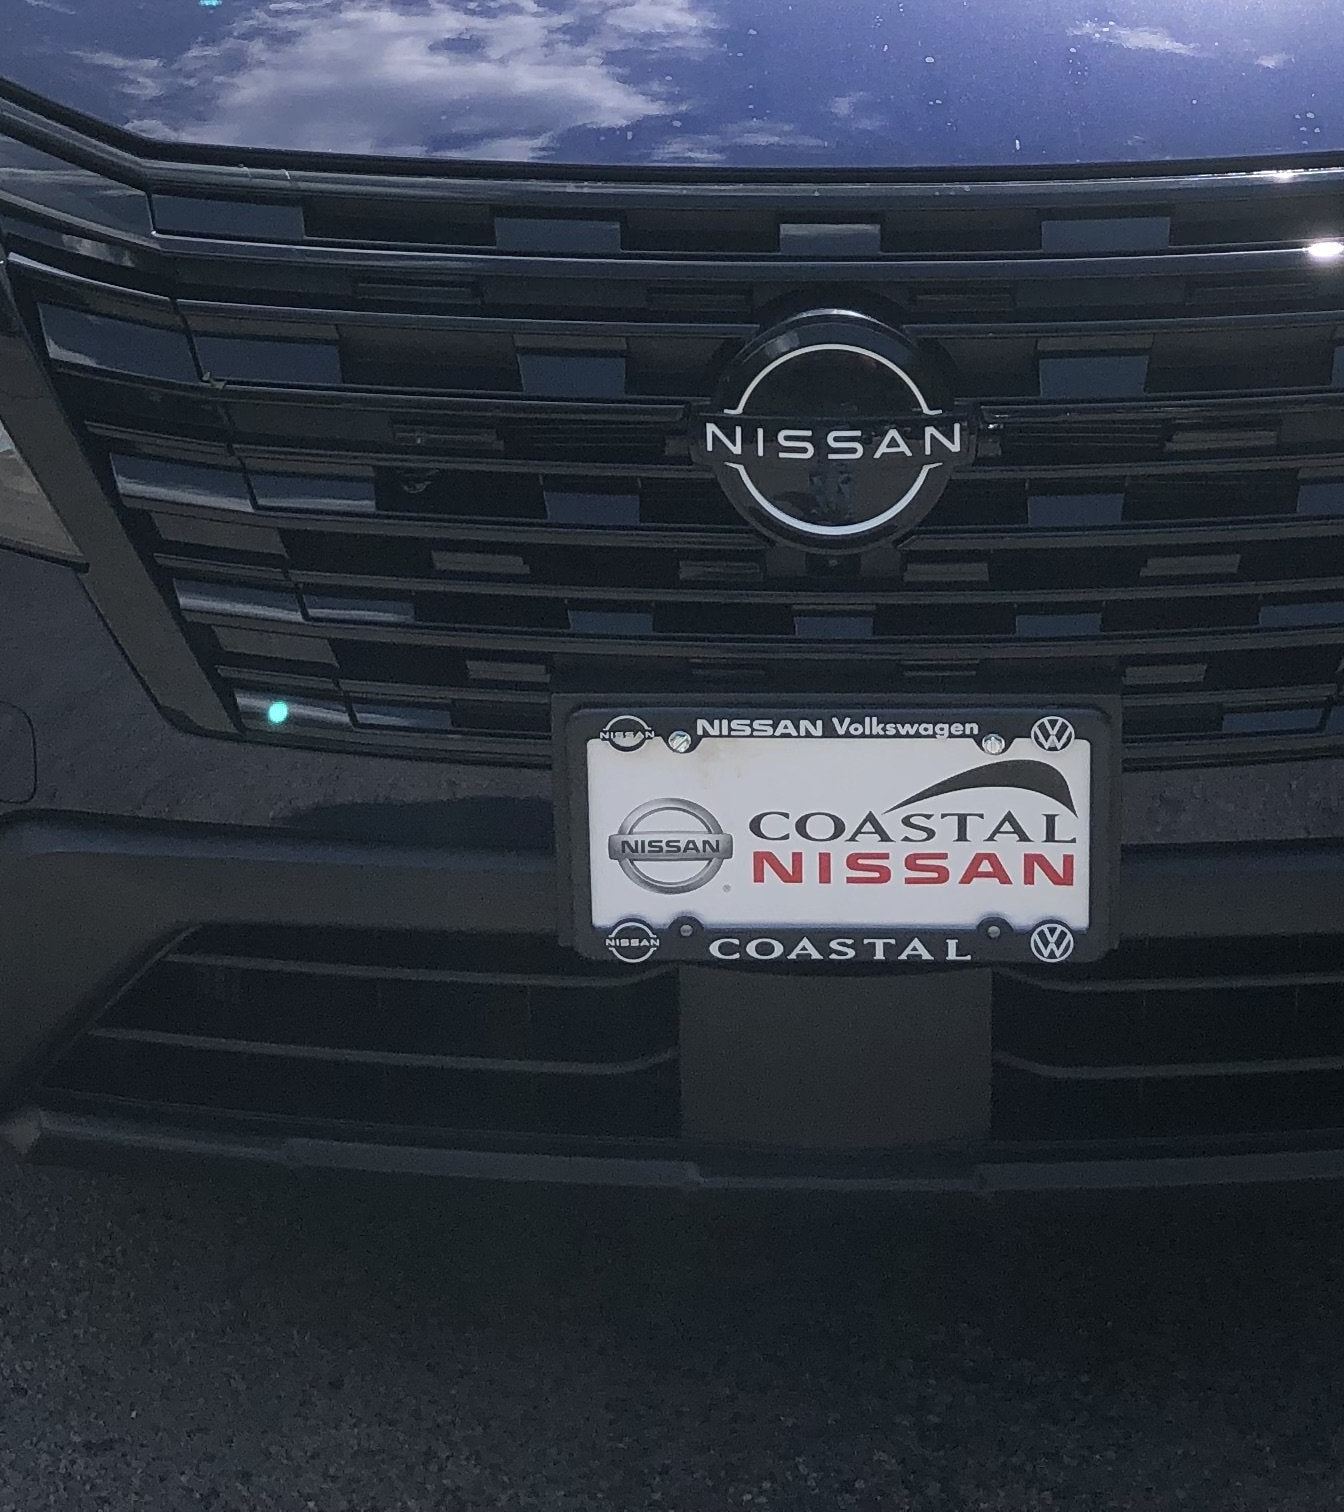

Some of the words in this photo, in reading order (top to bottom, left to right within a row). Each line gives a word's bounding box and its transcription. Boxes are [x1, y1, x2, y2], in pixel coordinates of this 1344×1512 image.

[705, 422, 961, 460] NISSAN
[696, 718, 823, 737] NISSAN
[831, 716, 979, 739] Volkswagen
[747, 809, 1078, 844] COASTAL
[621, 839, 720, 854] NISSAN
[752, 850, 1075, 887] NISSAN
[605, 938, 660, 947] NISSAN
[708, 936, 973, 961] COASTAL
